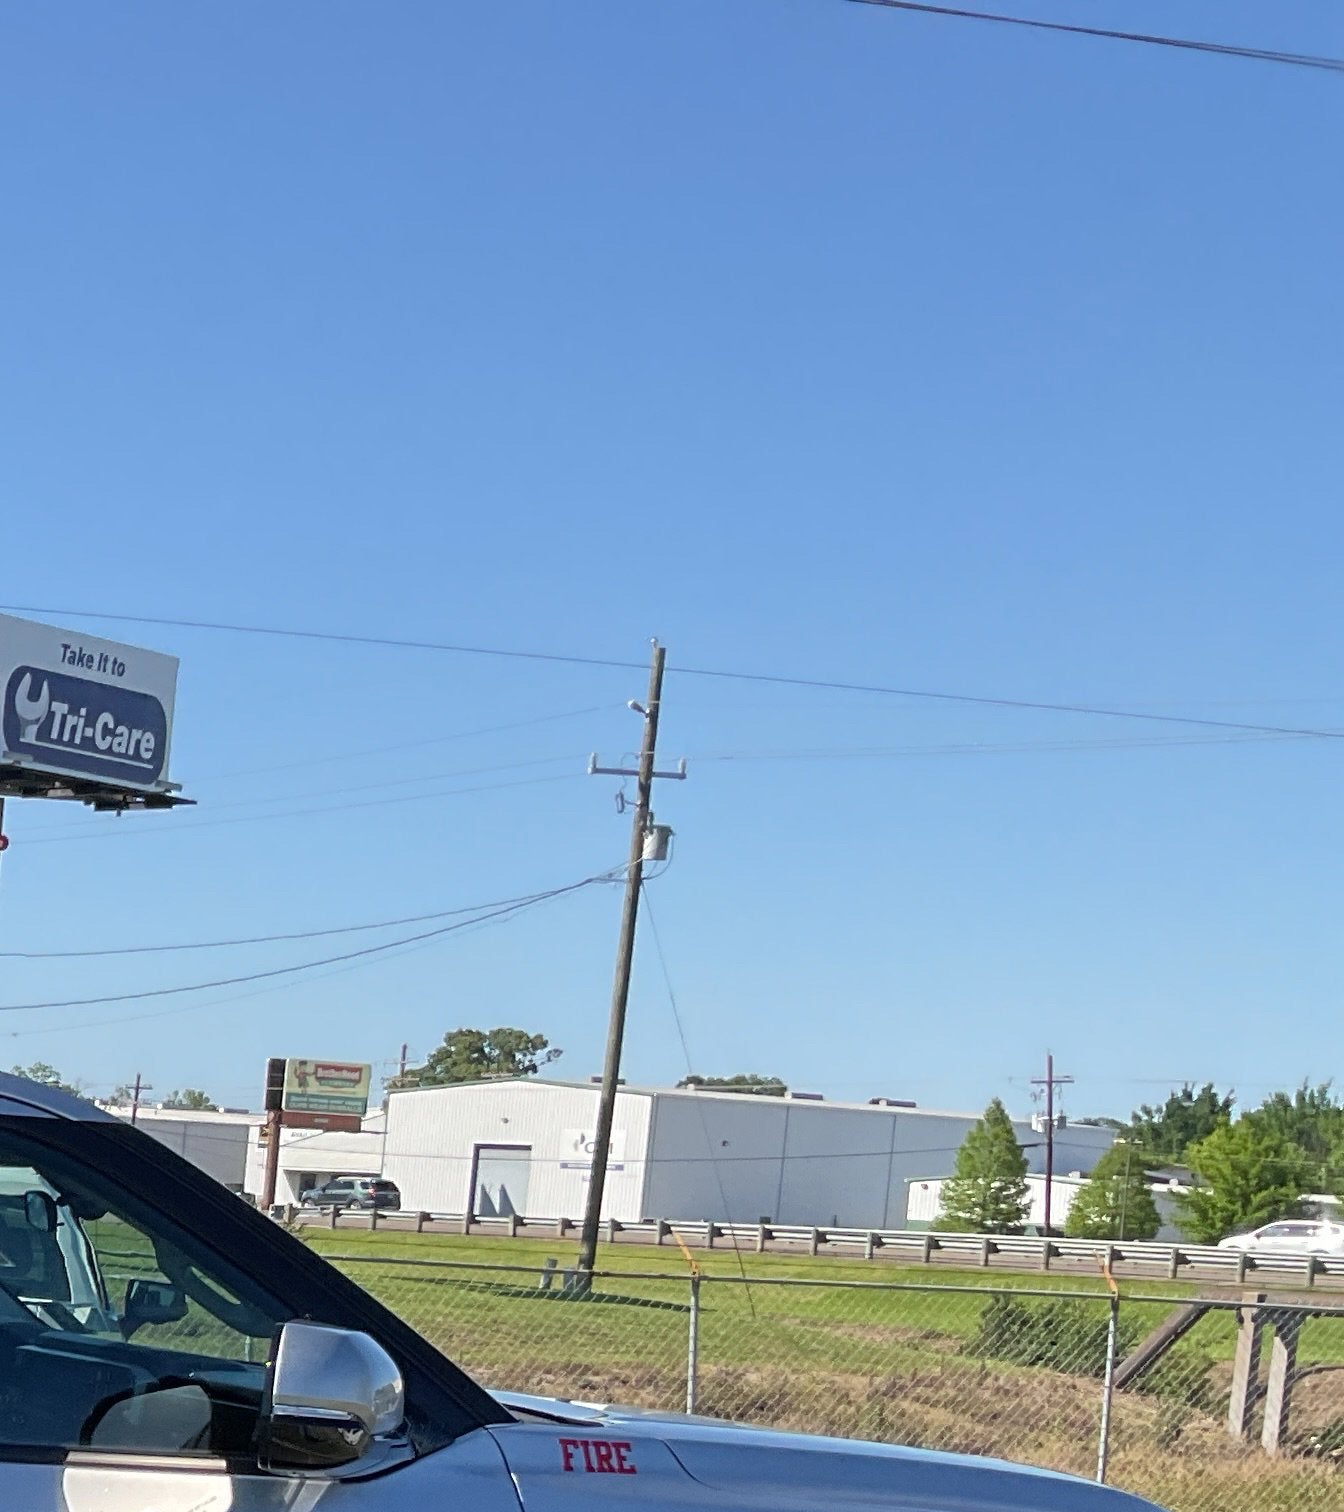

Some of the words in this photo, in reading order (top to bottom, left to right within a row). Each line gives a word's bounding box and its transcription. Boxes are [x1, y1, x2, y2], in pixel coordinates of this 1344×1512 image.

[61, 643, 94, 670] Take
[111, 656, 126, 677] to
[50, 701, 156, 759] Tri-Care
[559, 1438, 638, 1475] FIRE
